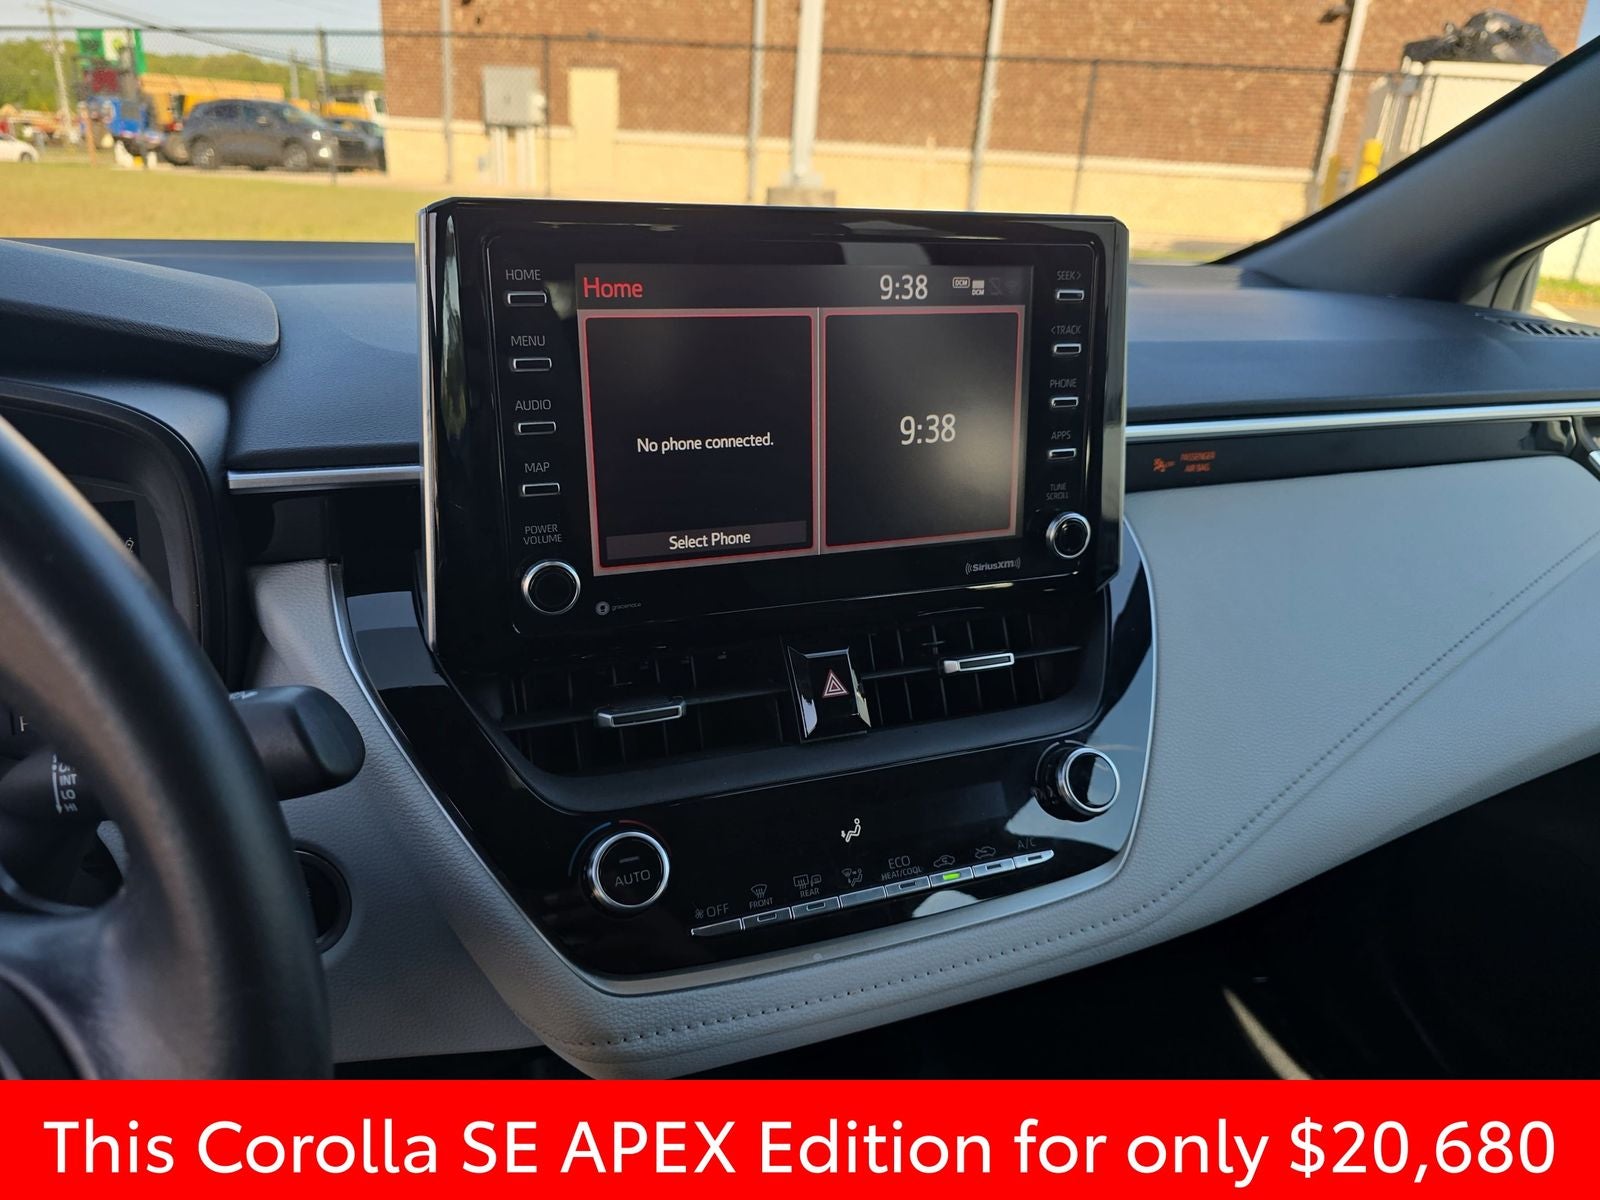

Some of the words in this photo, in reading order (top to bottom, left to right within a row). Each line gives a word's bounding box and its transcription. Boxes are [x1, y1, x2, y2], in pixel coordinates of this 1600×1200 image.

[505, 269, 541, 281] HOME
[583, 277, 643, 298] Home
[879, 274, 928, 300] 9:38
[510, 335, 546, 347] MENU
[1050, 379, 1077, 389] PHONE
[515, 399, 552, 412] AUDIO
[899, 413, 956, 446] 9:38
[1051, 430, 1071, 441] APPS
[637, 438, 658, 452] No
[661, 437, 702, 454] phone
[705, 432, 774, 449] connected.
[524, 461, 550, 473] MAP
[1050, 482, 1067, 491] TUNE
[1046, 492, 1069, 500] SCROLL
[525, 524, 558, 535] POWER
[523, 534, 562, 545] VOLUME
[669, 535, 708, 550] Select
[711, 532, 751, 546] Phone
[59, 773, 77, 786] INT
[60, 789, 76, 800] LO
[1017, 837, 1037, 849] A/C
[888, 855, 911, 870] ECO
[614, 869, 651, 888] AUTO
[881, 866, 922, 881] HEAT/COOL
[800, 887, 820, 898] REAR
[749, 897, 773, 909] FRONT
[706, 903, 729, 918] OFF
